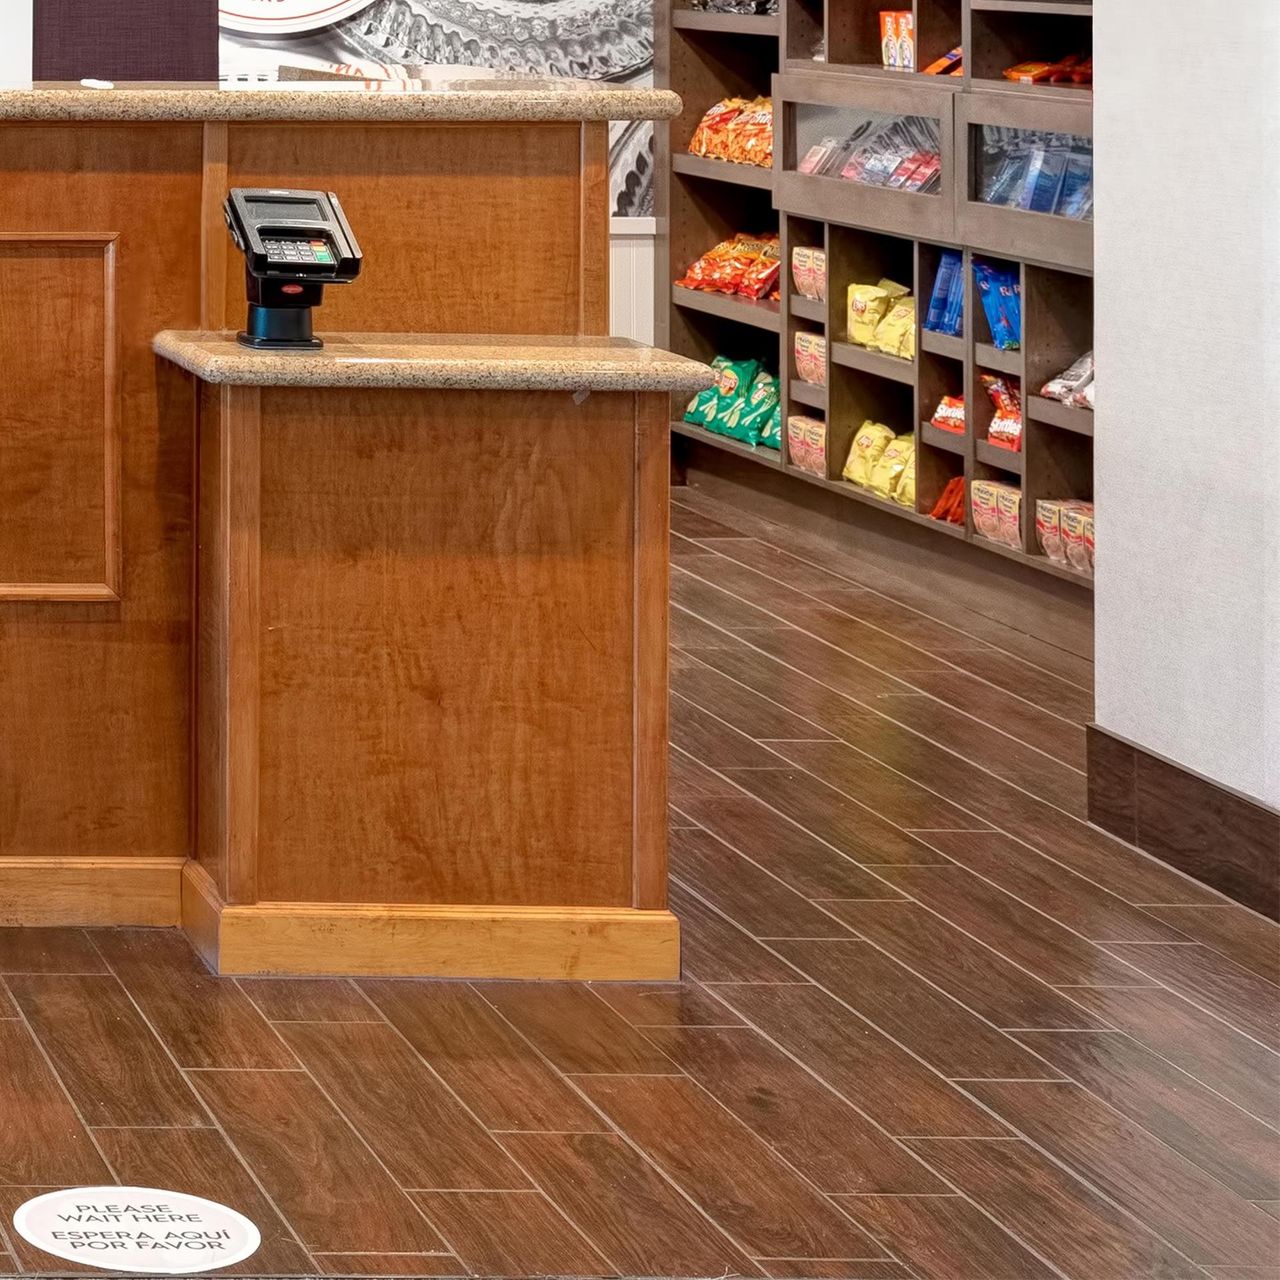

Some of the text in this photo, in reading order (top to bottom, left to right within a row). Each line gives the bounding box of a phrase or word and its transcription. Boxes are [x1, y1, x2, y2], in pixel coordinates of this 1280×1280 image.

[75, 1204, 173, 1213] PLEASE
[57, 1214, 203, 1223] WAIT HERE
[51, 1229, 231, 1240] ESPERA AQUÍ
[70, 1241, 226, 1250] POR FAVOR
